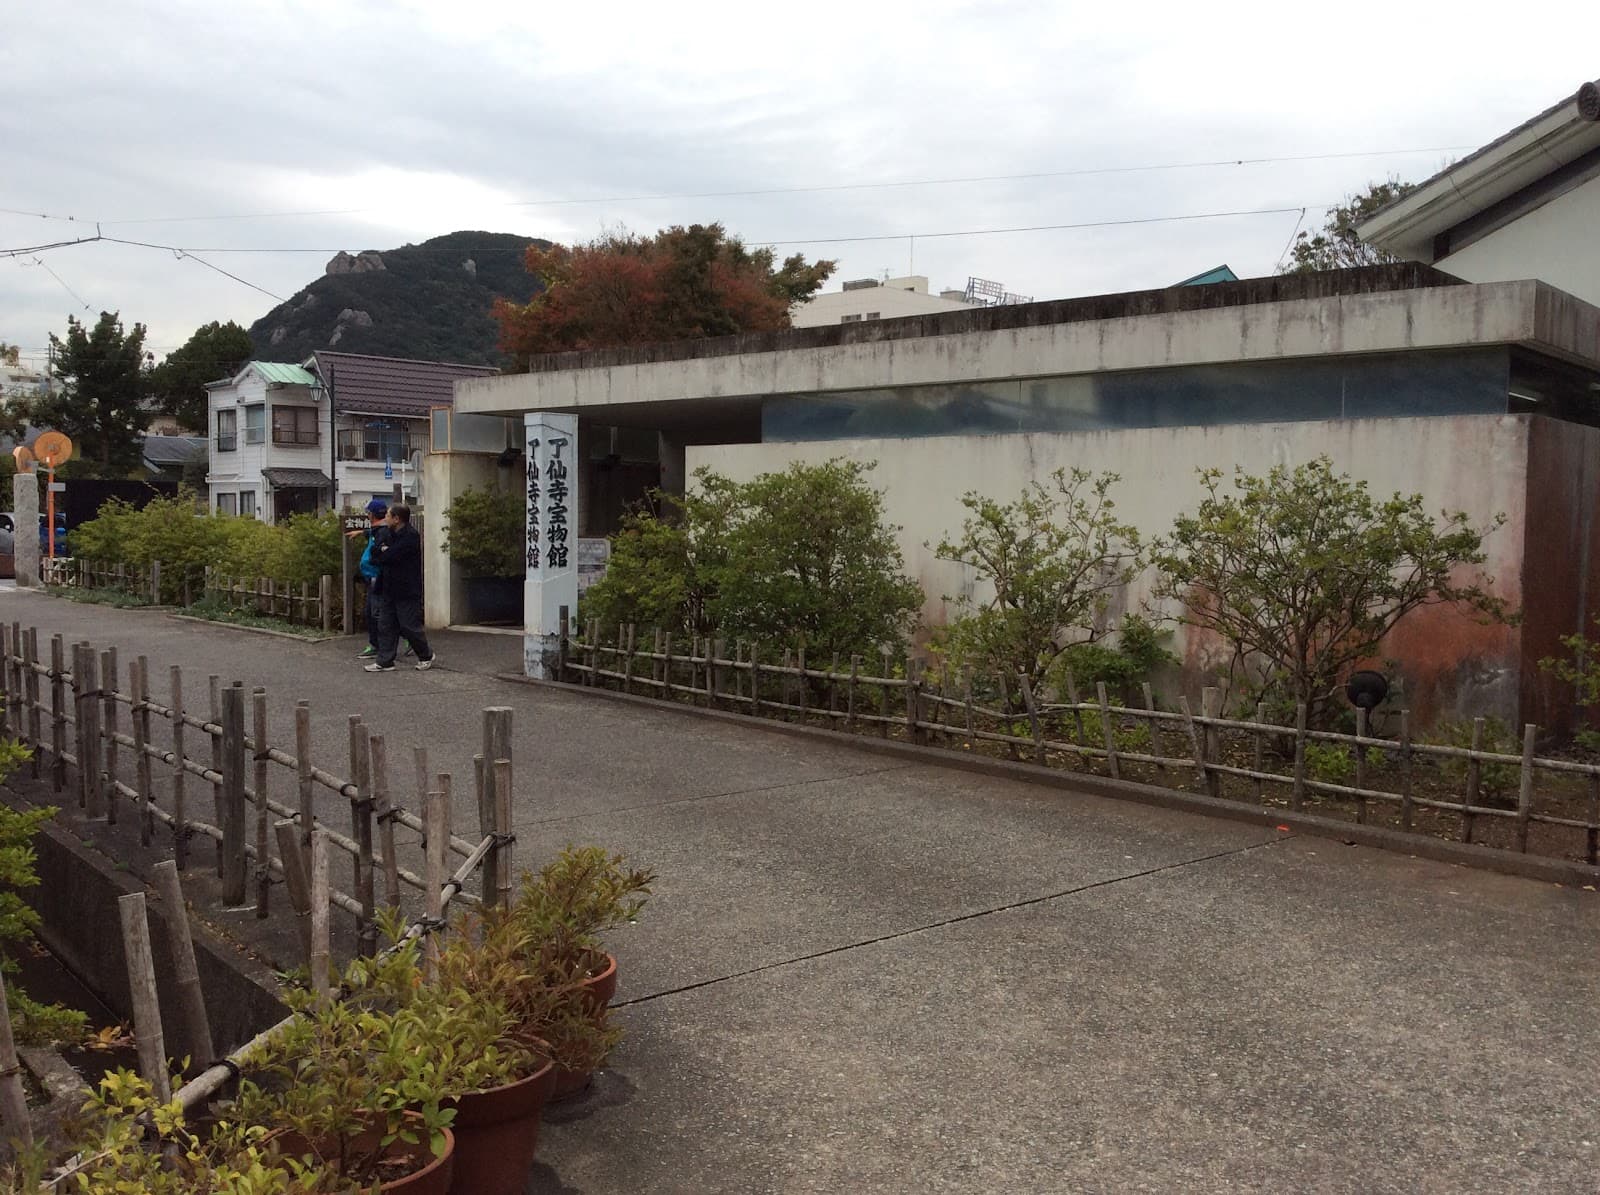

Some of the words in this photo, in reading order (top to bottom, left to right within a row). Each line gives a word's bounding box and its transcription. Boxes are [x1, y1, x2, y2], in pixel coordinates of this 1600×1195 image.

[527, 438, 540, 568] 了仙寺宝物館
[545, 438, 569, 568] 了仙寺宝物館
